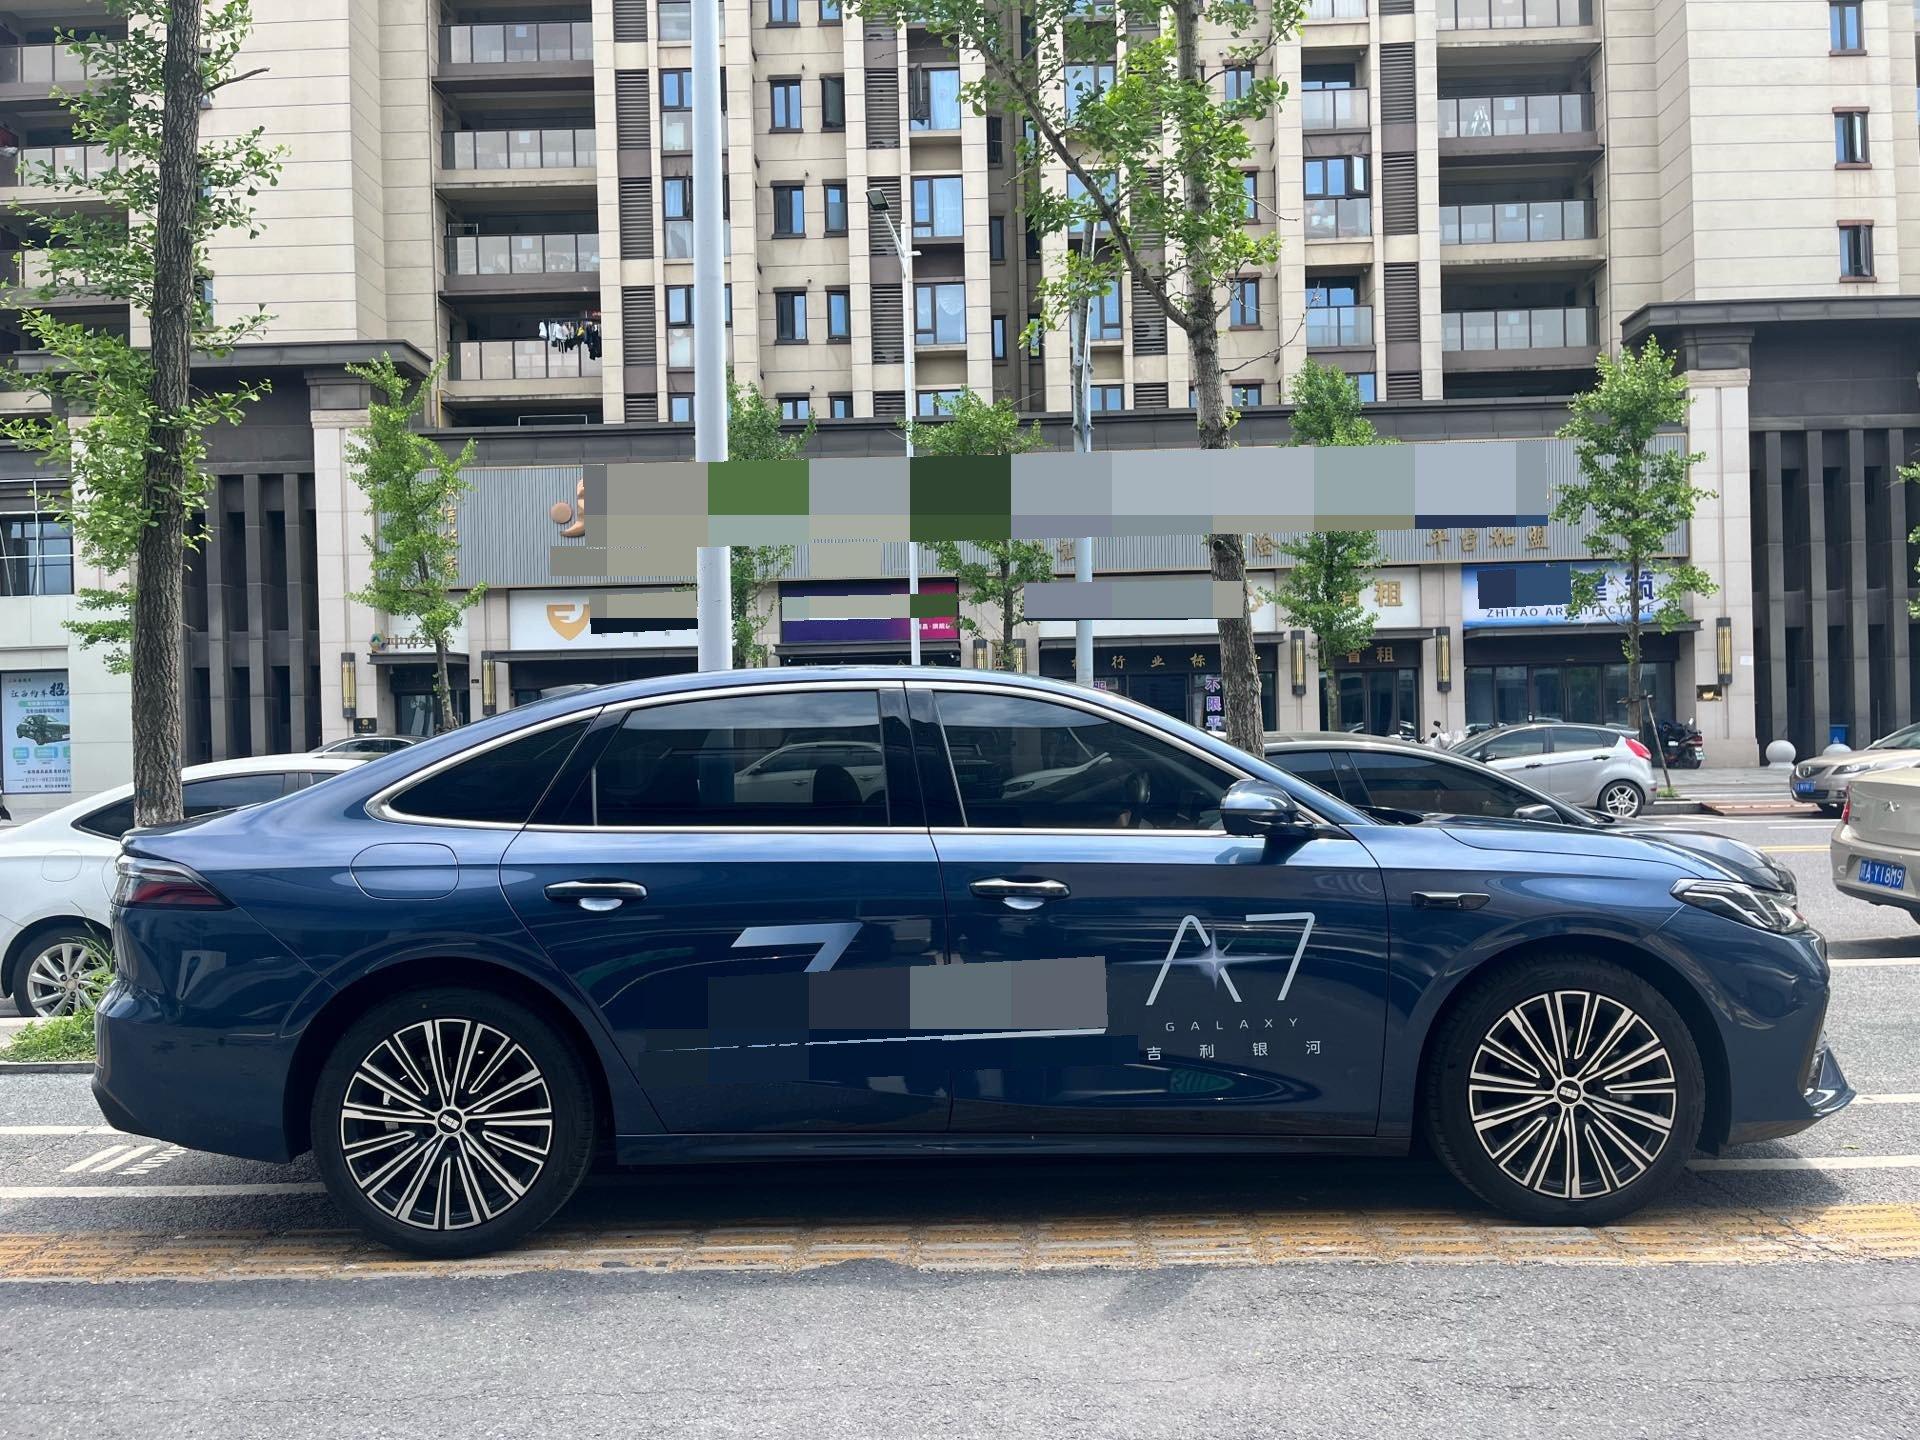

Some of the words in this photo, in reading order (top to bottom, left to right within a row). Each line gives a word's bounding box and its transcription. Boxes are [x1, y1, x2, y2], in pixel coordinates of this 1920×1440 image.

[1486, 607, 1539, 618] ZHITAO
[1545, 605, 1655, 617] ARITECTURE
[1145, 912, 1316, 1006] A7
[1165, 1017, 1298, 1032] GALAXY
[1146, 1040, 1321, 1061] 吉利银河
